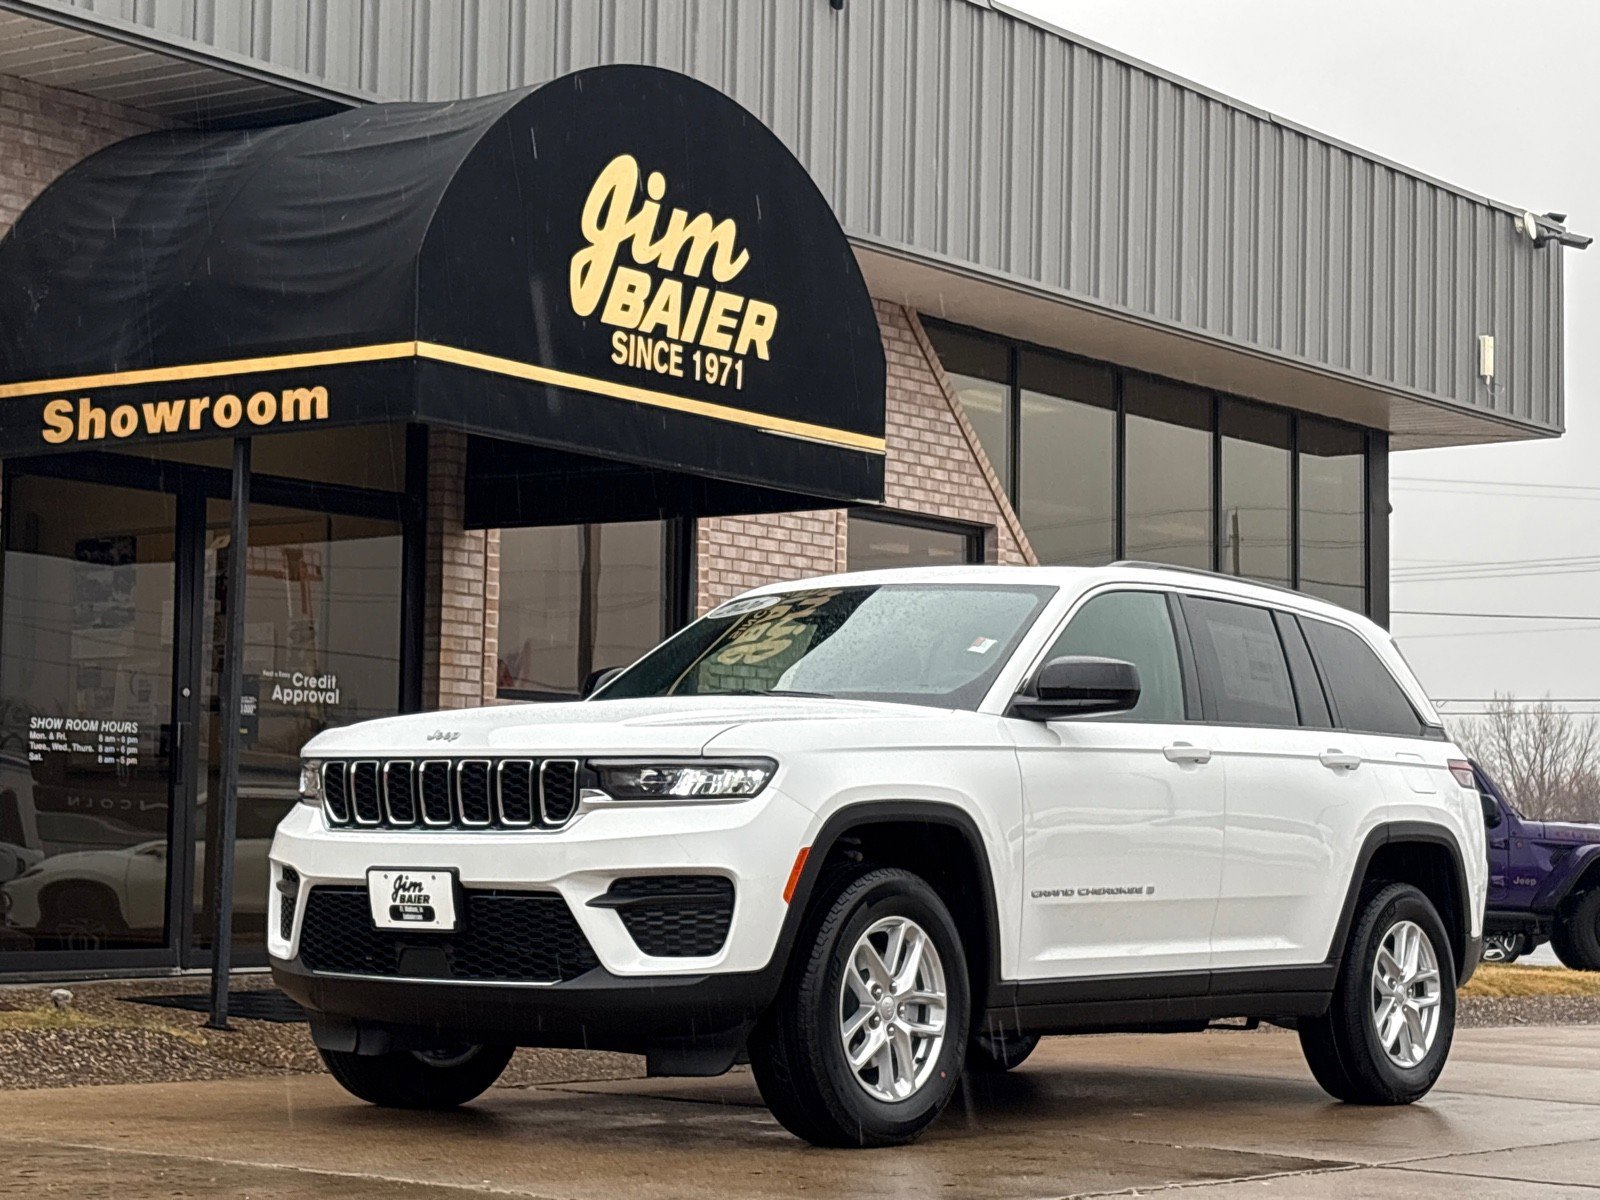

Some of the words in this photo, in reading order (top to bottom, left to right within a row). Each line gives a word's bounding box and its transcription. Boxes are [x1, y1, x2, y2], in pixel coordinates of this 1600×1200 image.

[570, 154, 750, 317] Jim
[600, 266, 778, 361] BAIER
[611, 331, 684, 377] SINCE
[693, 350, 743, 390] 1971
[42, 385, 329, 444] Showroom
[292, 672, 337, 689] Credit
[271, 684, 340, 705] Approval
[30, 717, 63, 729] SHOW
[65, 719, 99, 731] ROOM
[101, 721, 138, 733] HOURS
[29, 731, 47, 740] Mon.
[127, 736, 138, 745] pm
[427, 729, 461, 742] Jeep
[126, 747, 138, 755] pm
[126, 757, 137, 766] pm
[391, 874, 424, 903] Jim
[1512, 876, 1537, 886] Jeep
[399, 894, 430, 904] BAIER
[1031, 888, 1074, 898] GRAND
[1077, 886, 1143, 896] CHEROKEE
